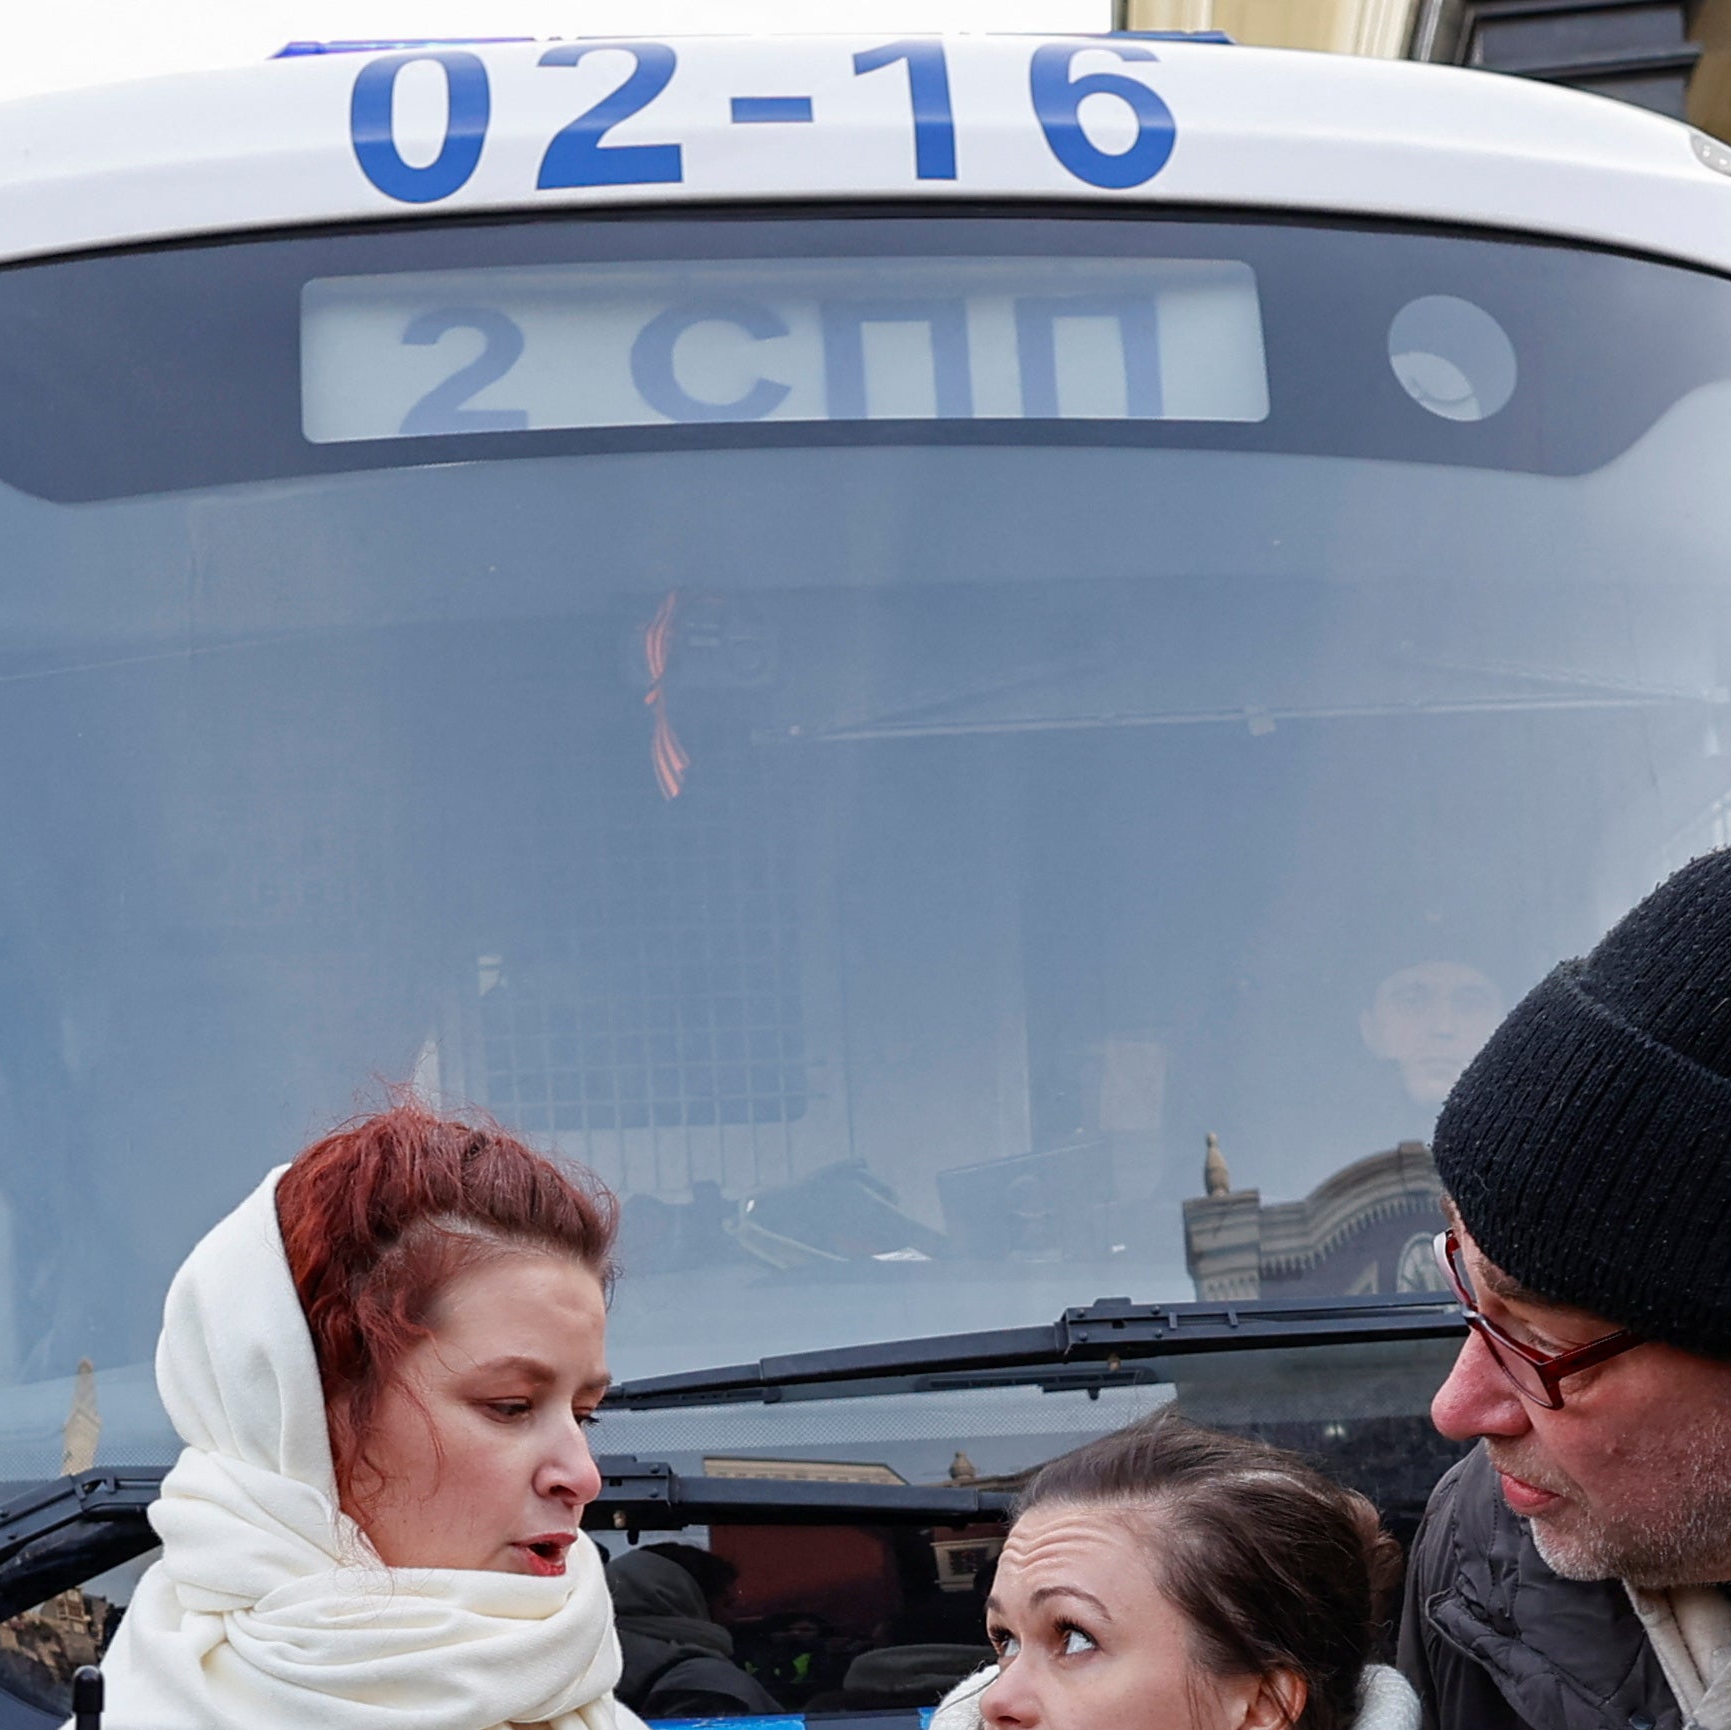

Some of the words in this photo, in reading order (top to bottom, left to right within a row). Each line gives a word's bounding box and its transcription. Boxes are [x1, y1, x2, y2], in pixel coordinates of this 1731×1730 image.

[349, 38, 1178, 201] 02-16
[399, 305, 529, 436] 2
[629, 294, 1165, 422] СПП
